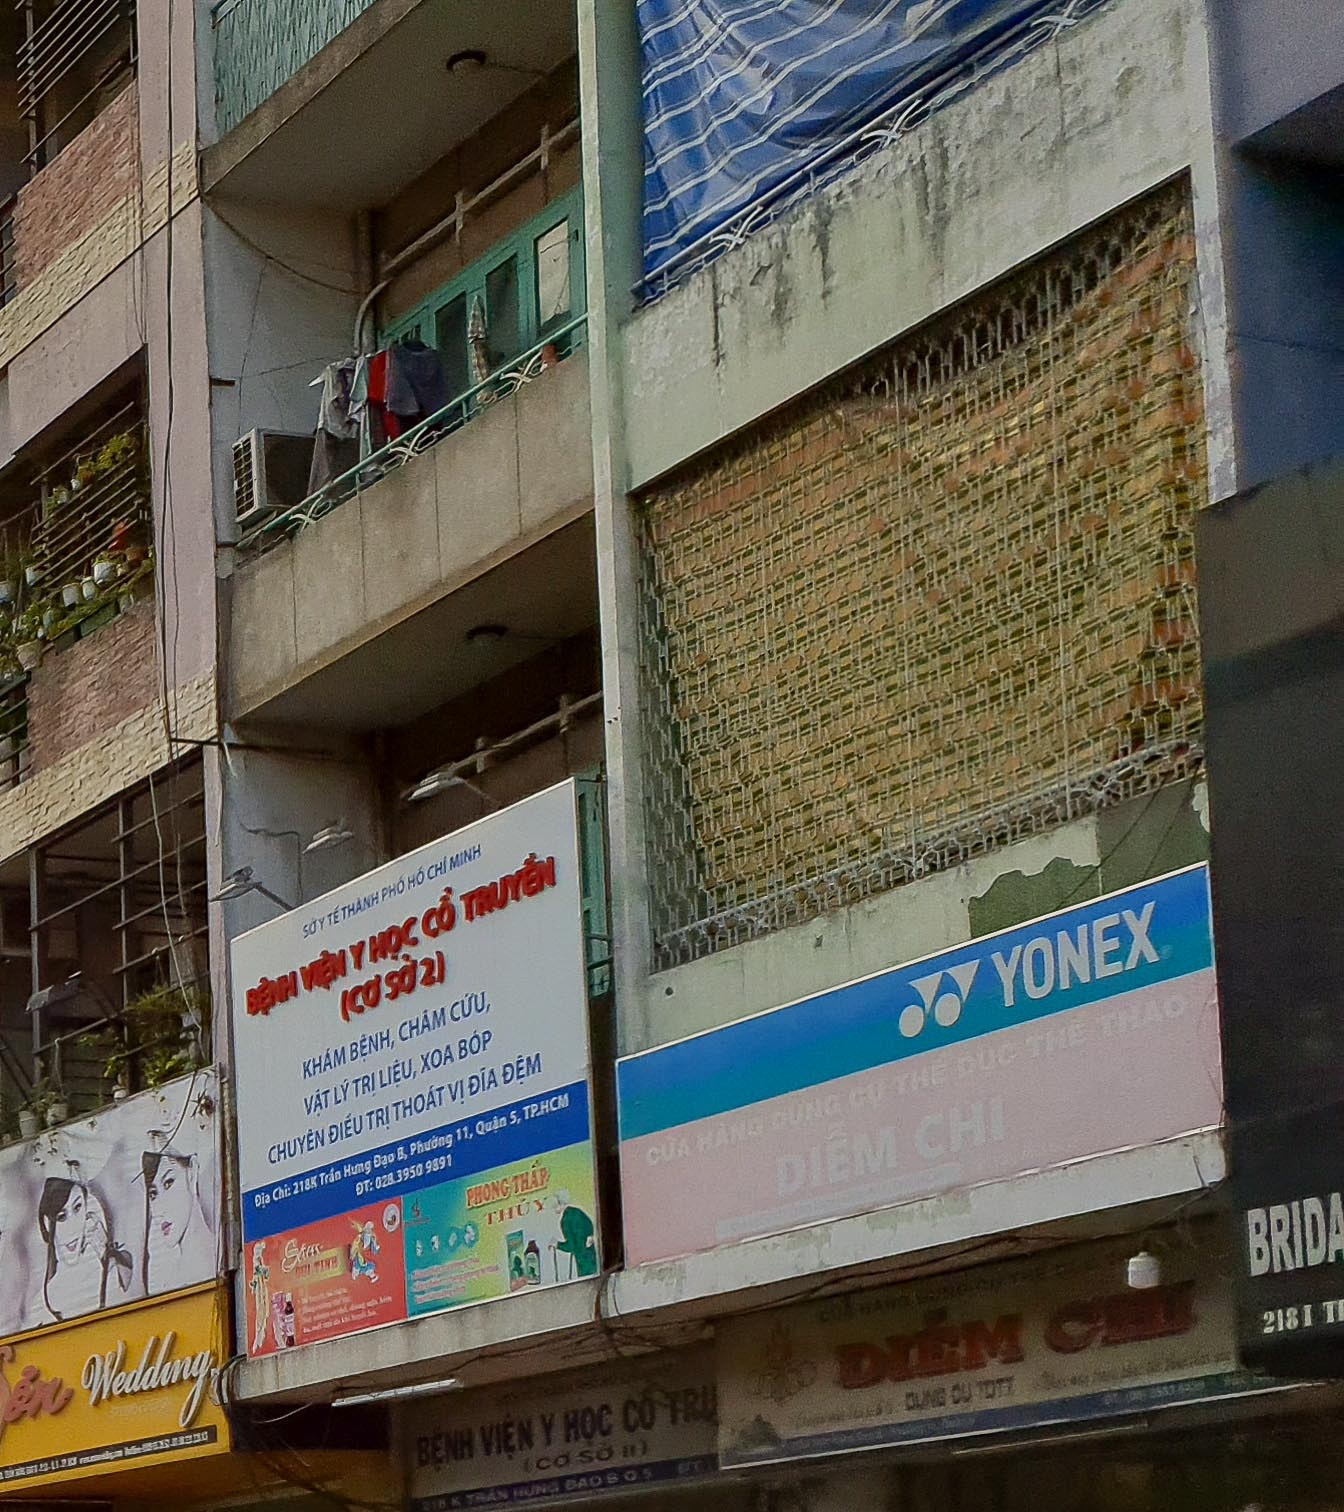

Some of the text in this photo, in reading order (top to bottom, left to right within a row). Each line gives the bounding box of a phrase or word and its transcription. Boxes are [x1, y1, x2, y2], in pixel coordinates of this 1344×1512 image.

[341, 893, 381, 922] THÀNH
[450, 844, 483, 876] MINH
[245, 852, 557, 1017] BỆNH VIỆN Y HỌC CỔ TRUYỀN
[384, 955, 419, 1000] SỞ
[419, 951, 447, 988] 2)
[992, 901, 1162, 1009] YONEX
[302, 990, 492, 1080] KHÁM BỆNH, CHÂM CỨU,
[303, 1029, 494, 1117] VẬT LÝ TRỊ LIỆU, XOA BÓP
[268, 1125, 326, 1165] CHUYÊN
[366, 1103, 392, 1133] TRỊ
[394, 1084, 447, 1121] THOÁT
[447, 1078, 465, 1106] VỊ
[502, 1051, 543, 1088] ĐỆM
[915, 1100, 1007, 1163] CHI
[80, 1330, 215, 1428] Wedding
[416, 1426, 475, 1471] BỆNH
[478, 1413, 535, 1461] VIỆN
[540, 1411, 556, 1447] Y
[563, 1403, 614, 1445] HỌC
